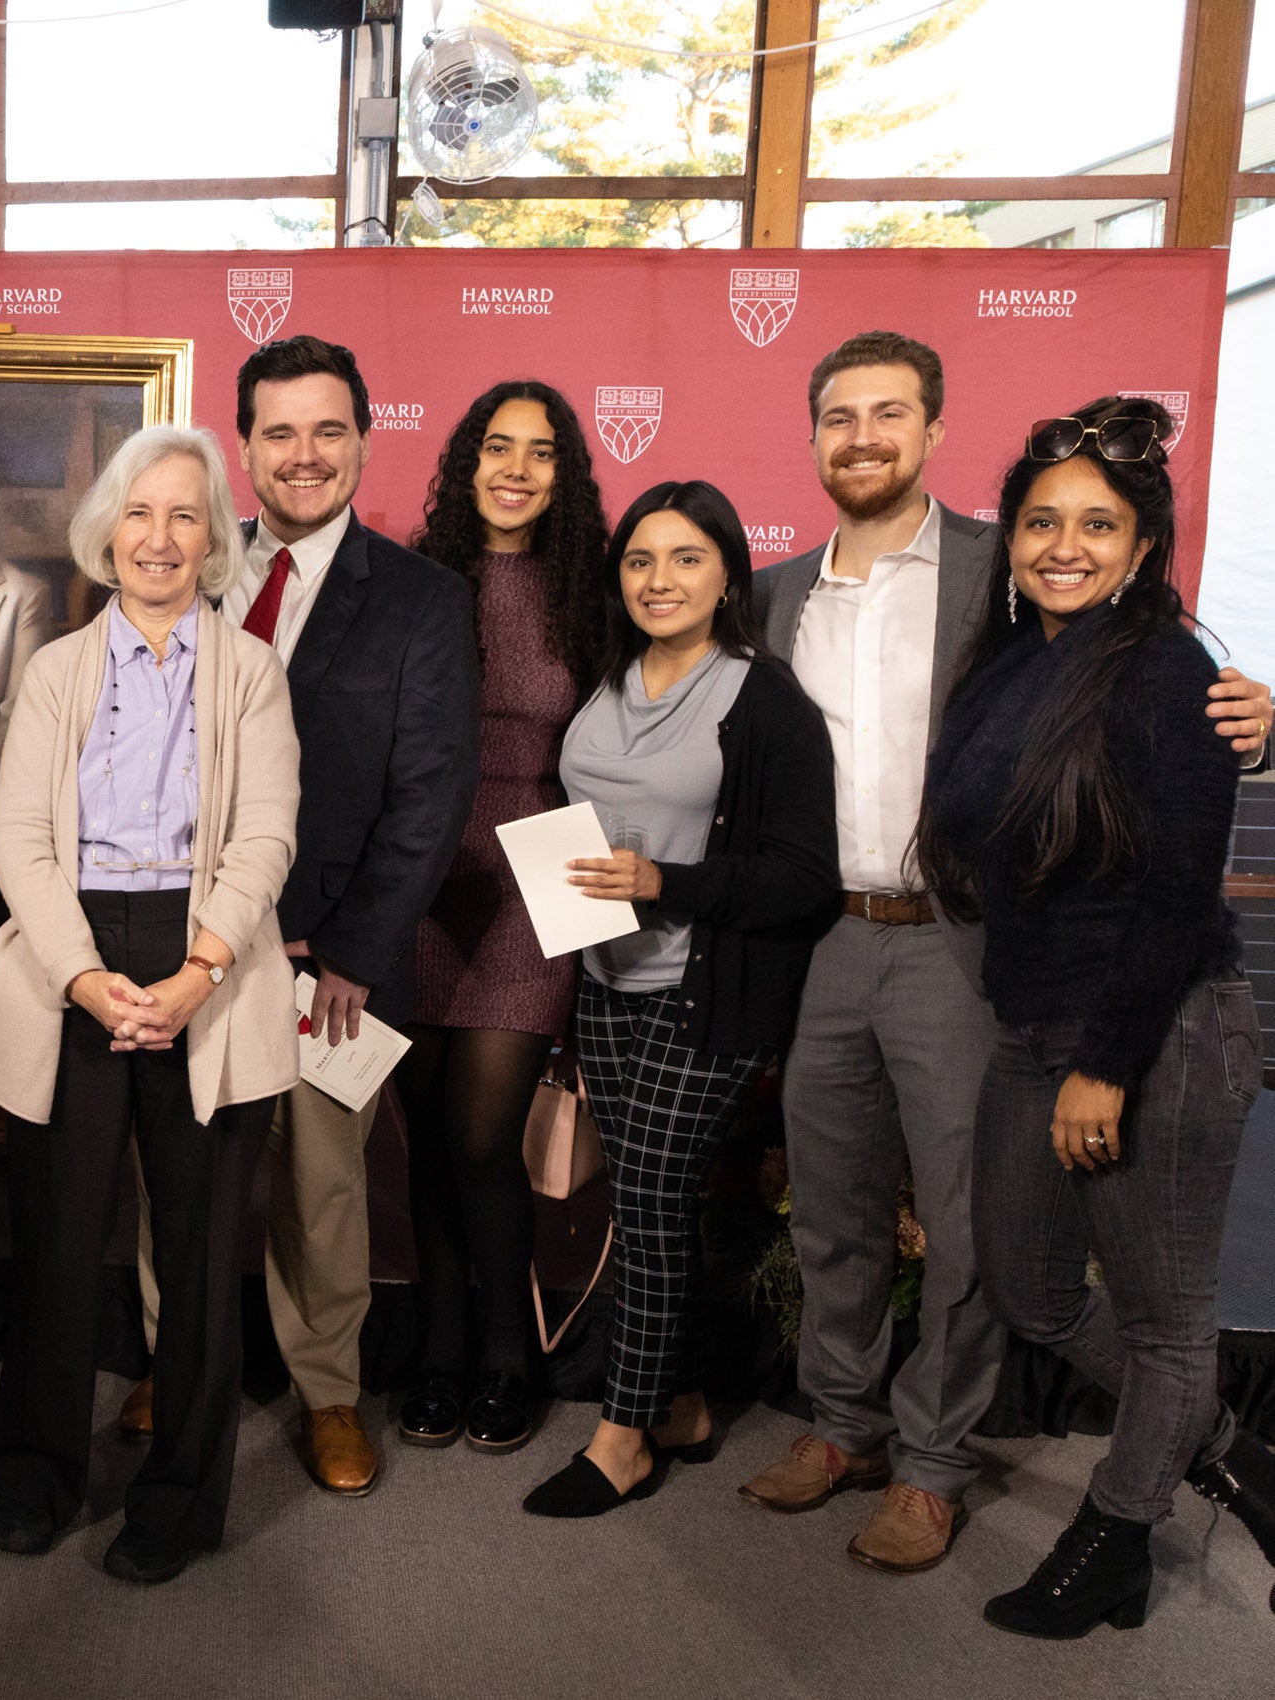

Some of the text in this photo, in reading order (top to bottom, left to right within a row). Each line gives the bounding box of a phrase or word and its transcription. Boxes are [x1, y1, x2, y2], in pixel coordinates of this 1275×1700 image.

[462, 288, 554, 302] HARVARD
[978, 289, 1077, 305] HARVARD
[6, 304, 60, 314] SCHOOL
[462, 303, 551, 315] LAW SCHOOL
[978, 306, 1073, 317] LAW SCHOOL
[744, 526, 795, 540] VARD
